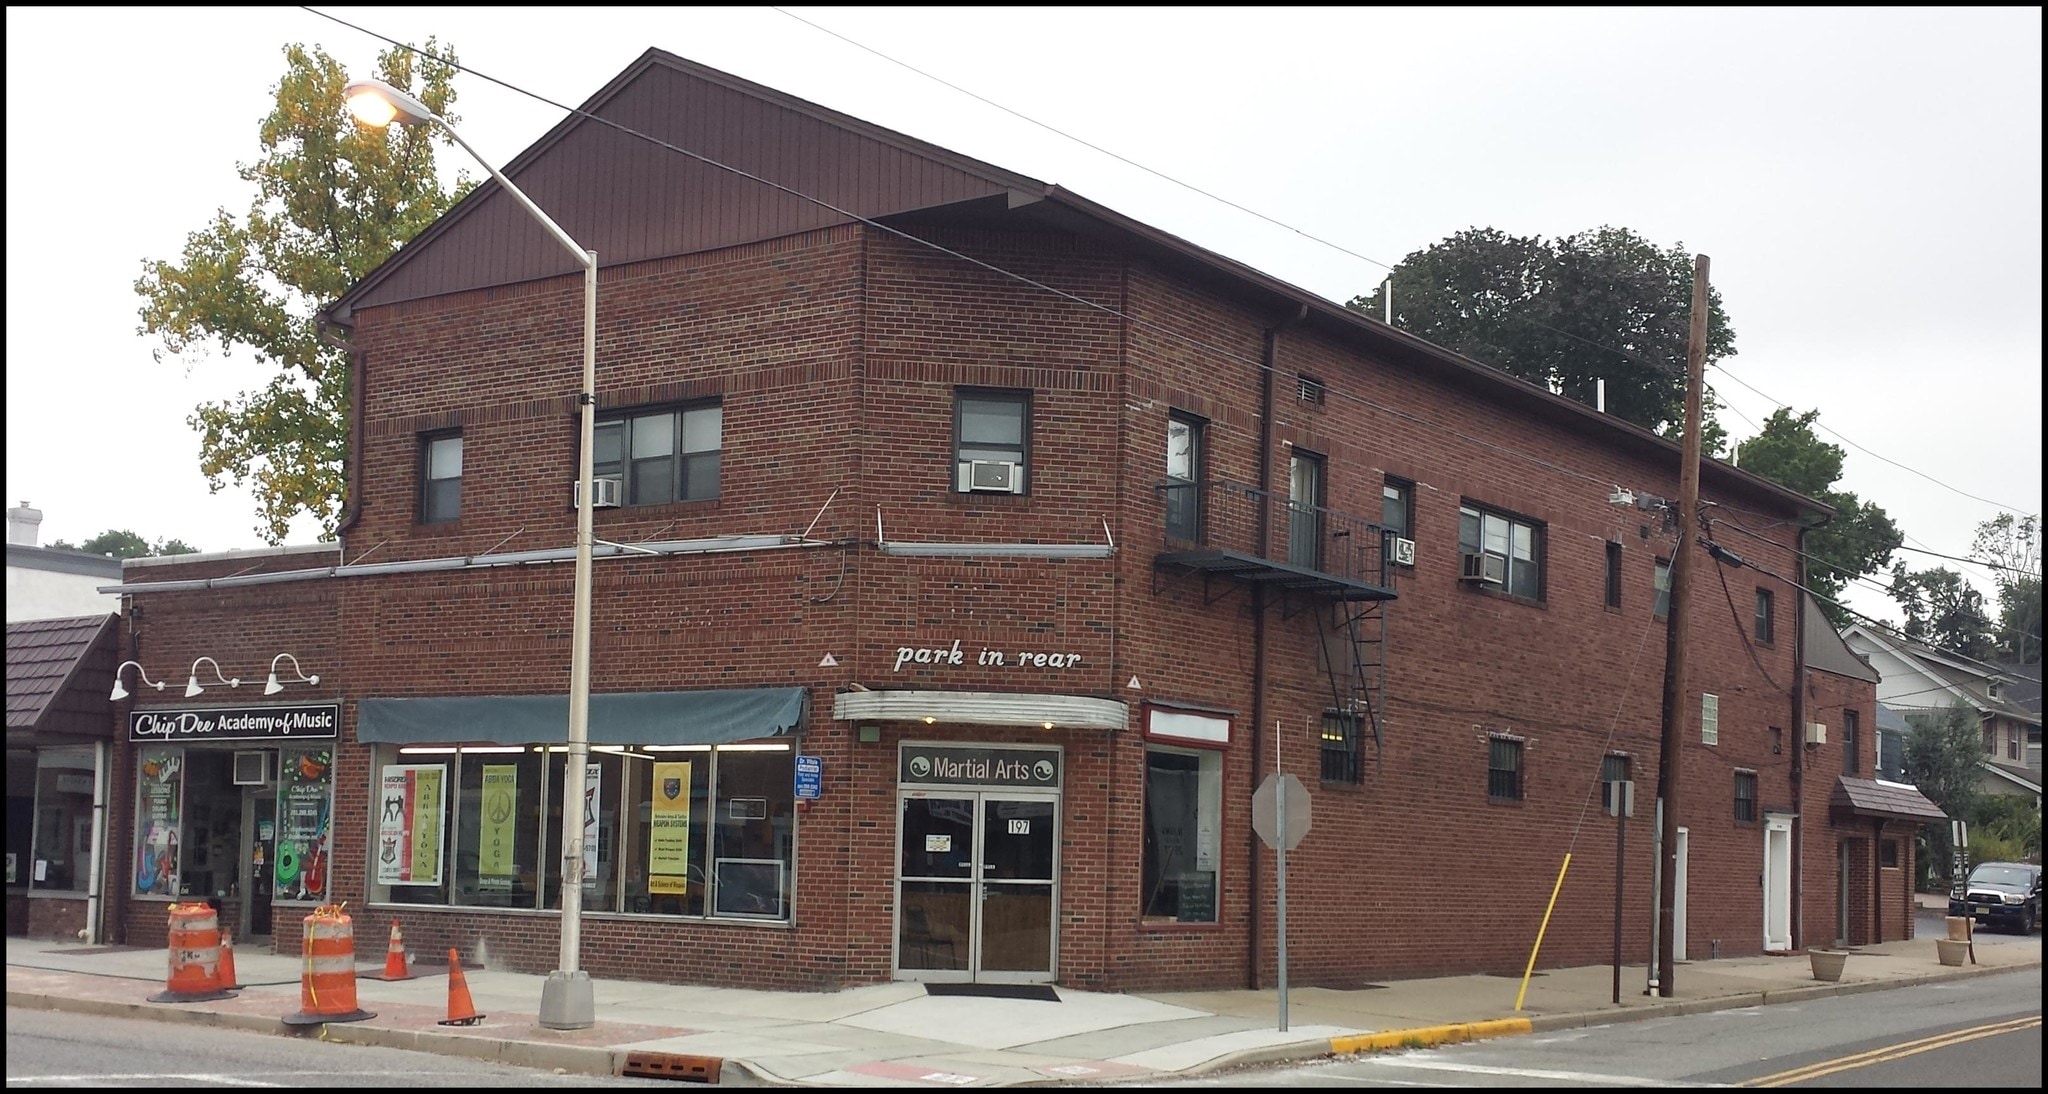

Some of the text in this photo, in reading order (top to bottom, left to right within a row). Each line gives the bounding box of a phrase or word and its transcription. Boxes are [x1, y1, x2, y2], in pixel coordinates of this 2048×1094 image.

[893, 639, 1081, 672] park in rear
[135, 712, 332, 741] Chip Dee Academy of Music
[934, 757, 1030, 780] Martial Arts
[1010, 820, 1029, 834] 197
